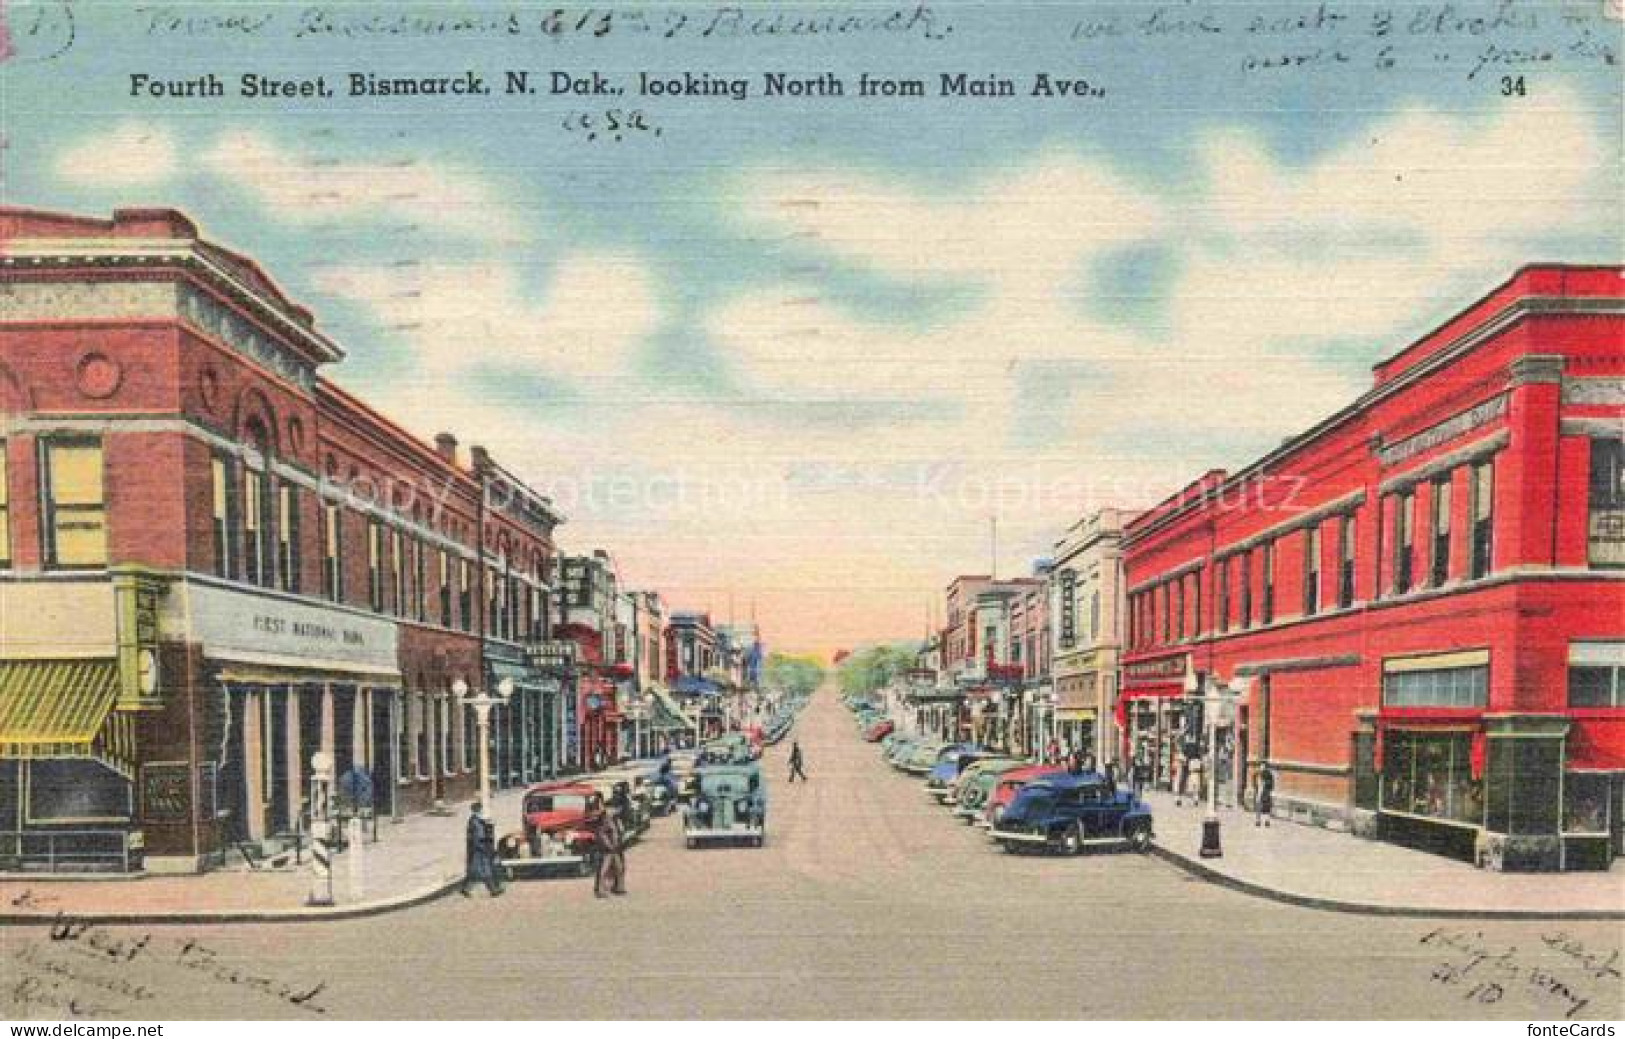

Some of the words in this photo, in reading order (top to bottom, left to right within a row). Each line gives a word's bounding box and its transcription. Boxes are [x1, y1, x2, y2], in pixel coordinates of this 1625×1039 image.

[129, 73, 224, 98] Fourth
[505, 71, 535, 94] N.
[640, 71, 749, 101] looking
[763, 71, 844, 96] North
[859, 73, 925, 96] from
[939, 73, 1016, 96] Main
[1501, 75, 1526, 96] 34
